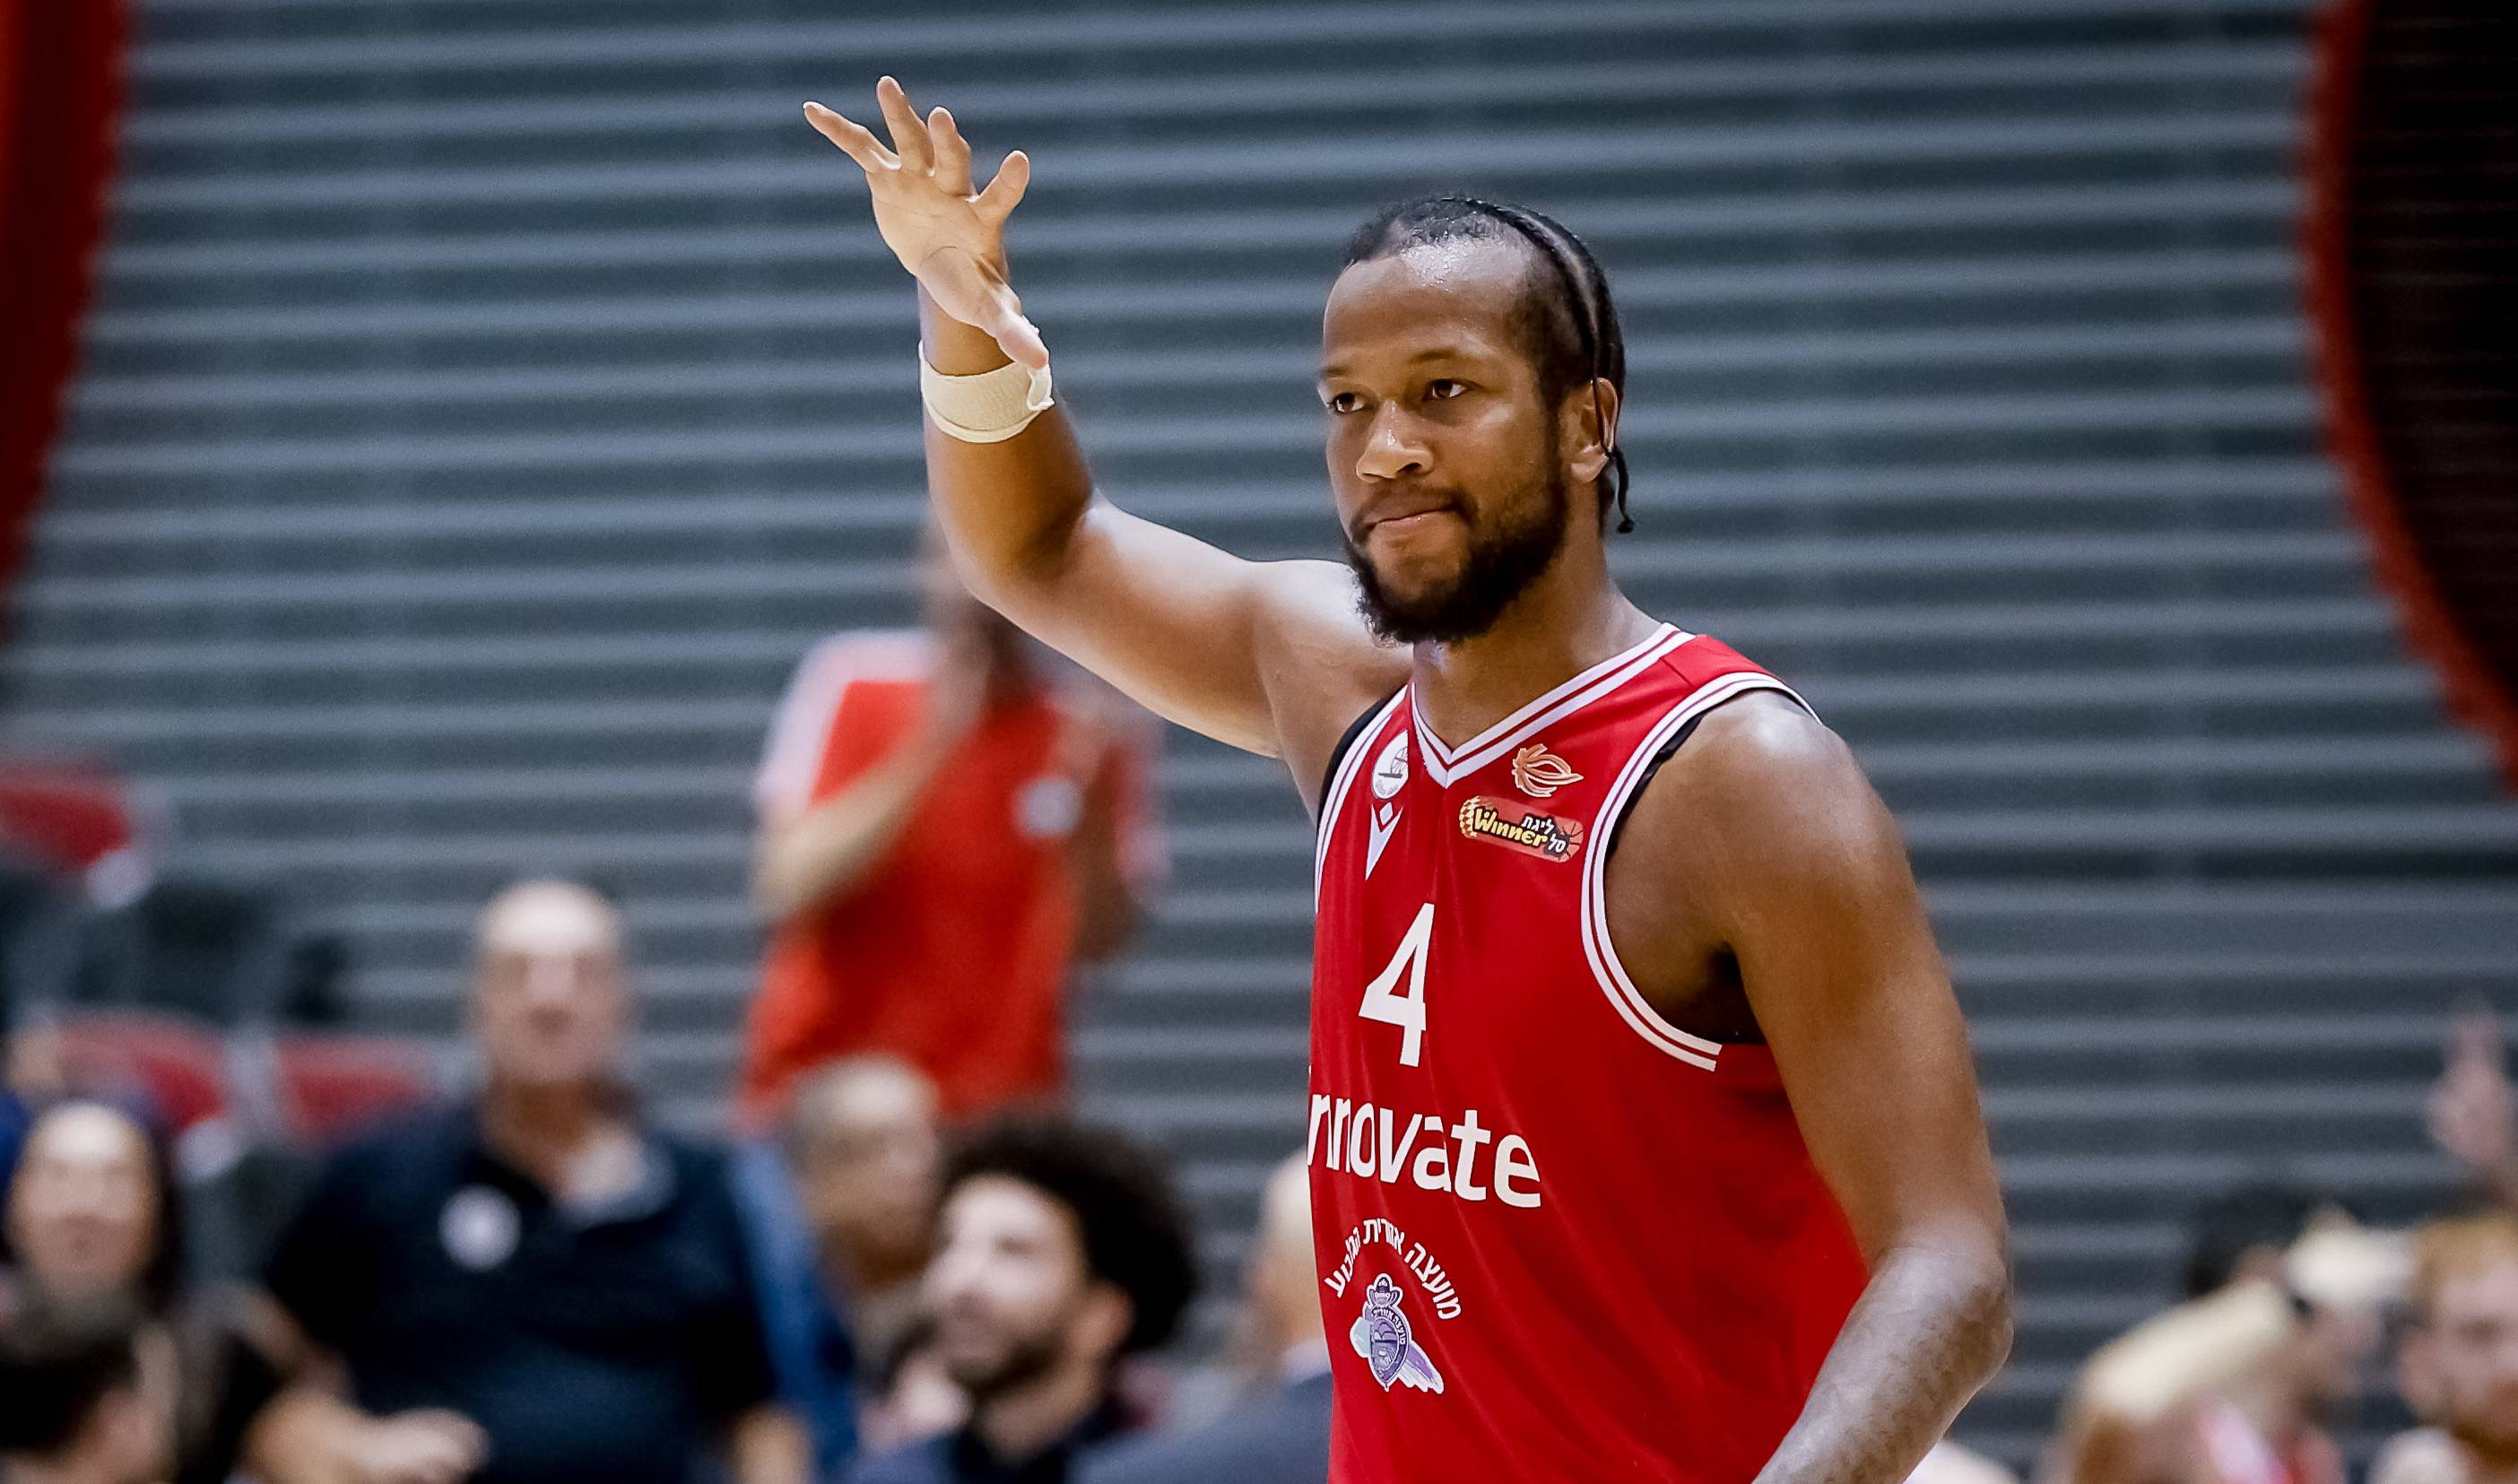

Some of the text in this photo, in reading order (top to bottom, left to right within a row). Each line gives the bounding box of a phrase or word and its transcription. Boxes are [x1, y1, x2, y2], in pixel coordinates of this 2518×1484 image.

[1473, 807, 1549, 847] Winner
[1521, 814, 1555, 835] ליגת
[1548, 833, 1567, 854] סל
[1358, 902, 1435, 1067] 4
[1307, 1092, 1541, 1208] nnovate
[1403, 1241, 1462, 1320] מועצה
